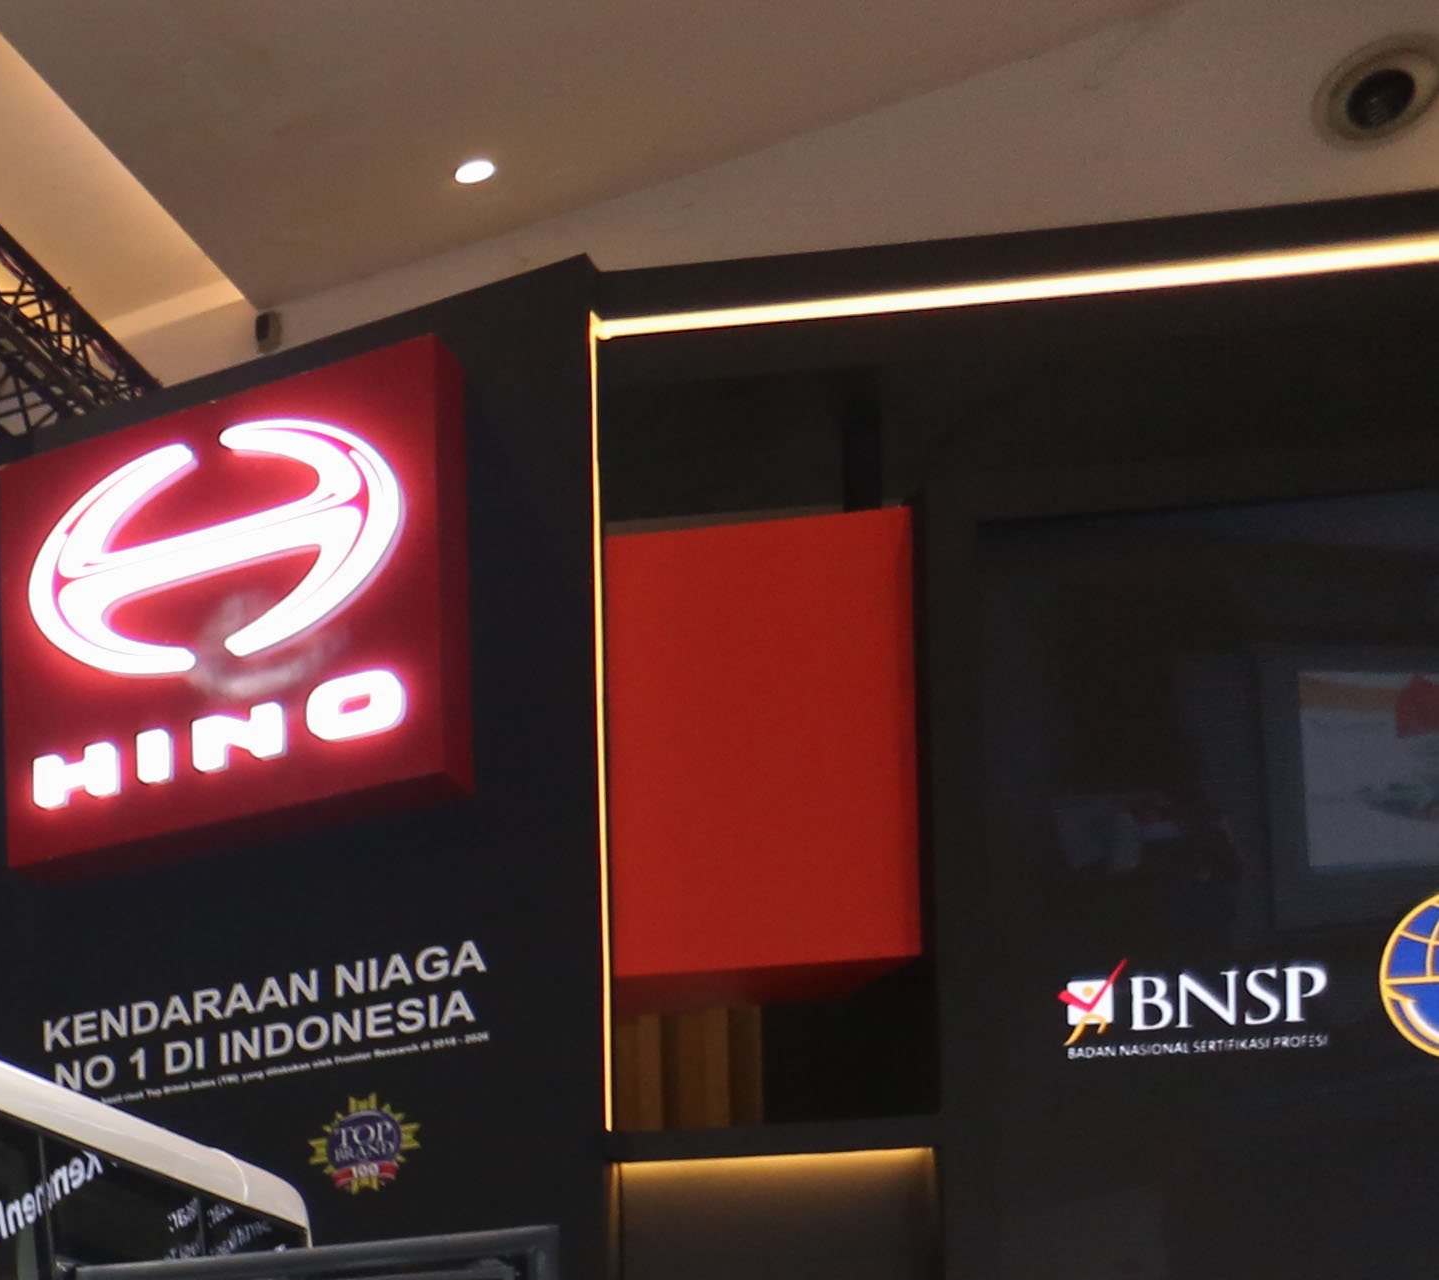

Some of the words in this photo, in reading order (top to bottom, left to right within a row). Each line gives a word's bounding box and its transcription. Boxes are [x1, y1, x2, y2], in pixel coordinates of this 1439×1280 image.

[31, 669, 406, 810] HINO
[43, 969, 320, 1053] KENDARAAN
[334, 940, 487, 998] NIAGA
[54, 1054, 116, 1094] NO
[129, 1046, 147, 1081] 1
[163, 1036, 206, 1076] DI
[219, 989, 477, 1066] INDONESIA
[1067, 1043, 1116, 1059] BADAN
[1119, 1040, 1189, 1057] NASIONAL
[1192, 1037, 1270, 1053] SERTIFIKASI
[1273, 1033, 1329, 1050] PROFESI
[1129, 965, 1328, 1031] BNSP
